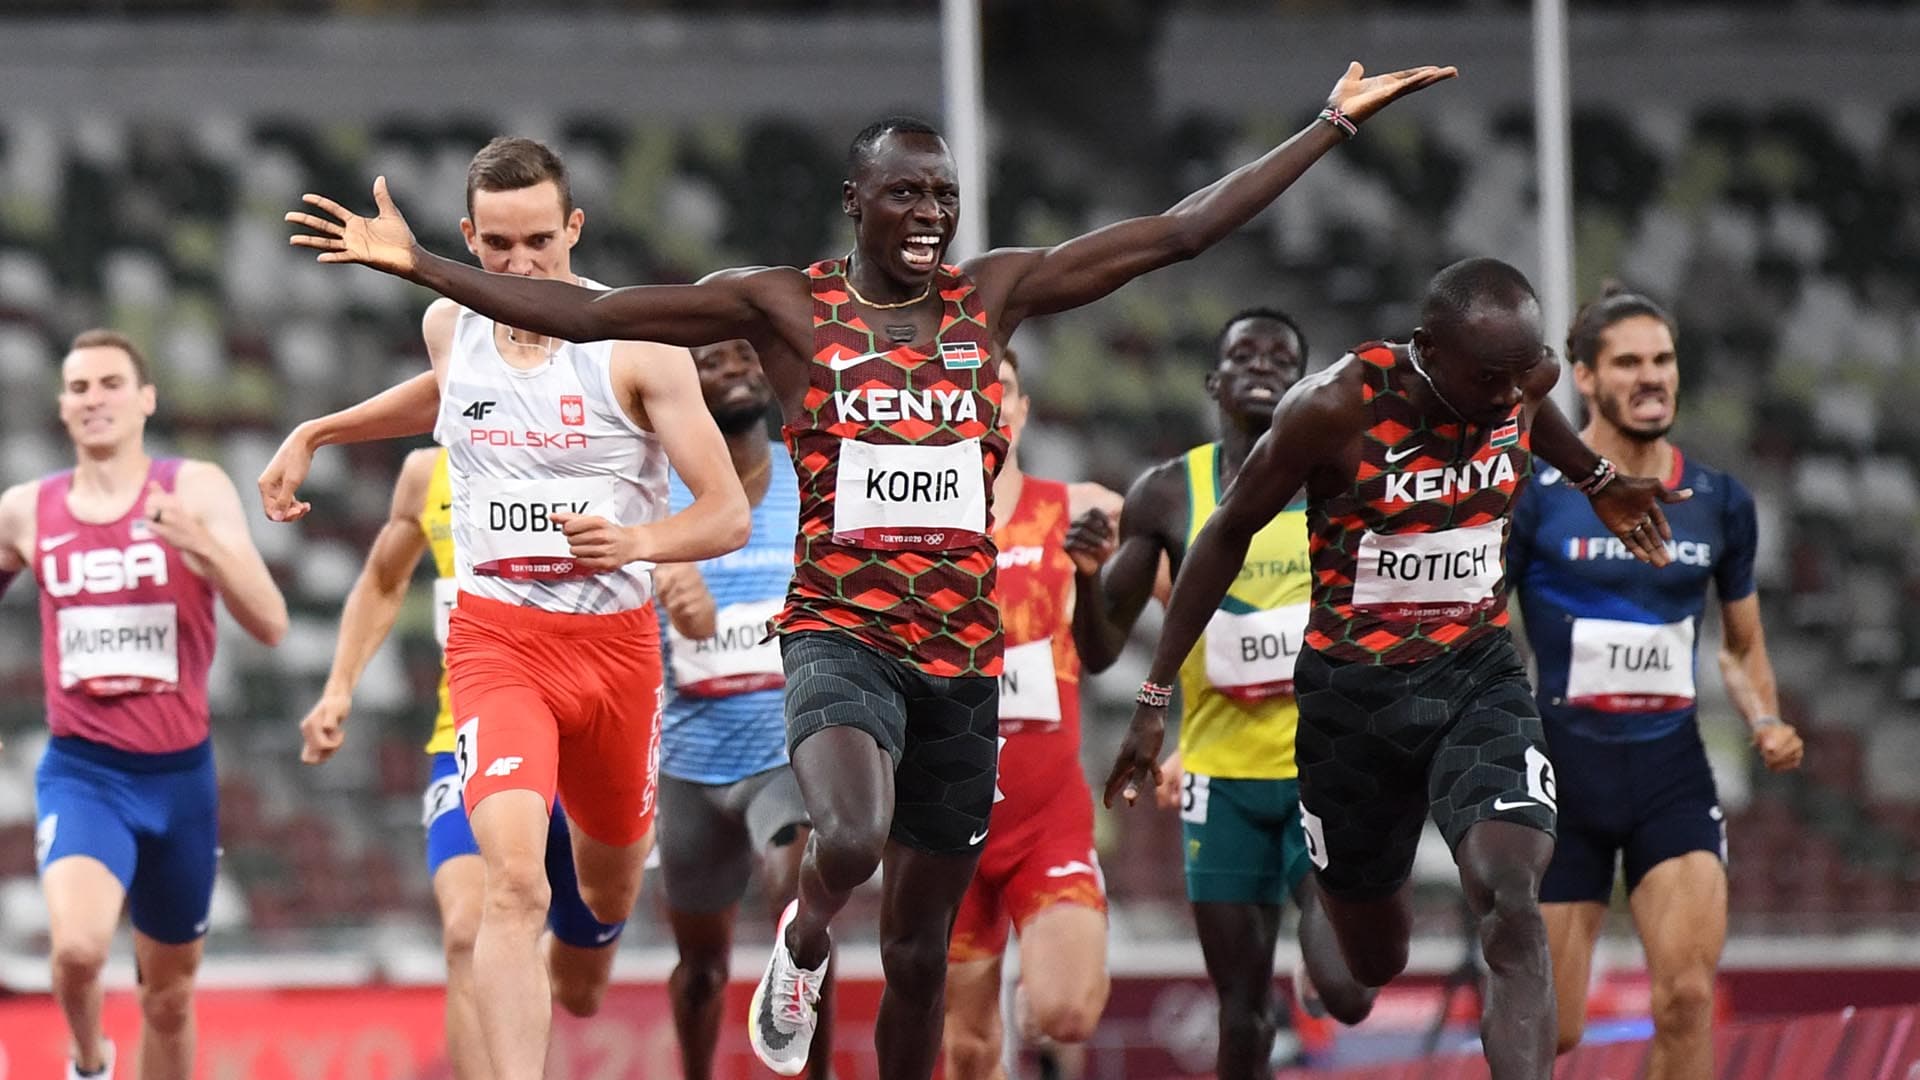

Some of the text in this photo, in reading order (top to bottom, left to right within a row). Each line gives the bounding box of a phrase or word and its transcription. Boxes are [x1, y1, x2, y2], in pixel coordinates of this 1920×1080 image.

[463, 401, 496, 420] 4F
[834, 388, 978, 424] KENYA
[470, 429, 587, 449] POLSKA
[866, 468, 959, 502] KORIR
[1384, 453, 1515, 503] KENYA
[880, 534, 903, 543] TOKYO
[1588, 537, 1711, 567] FRNCE
[41, 543, 169, 598] USA
[1377, 545, 1487, 581] ROTICH
[64, 626, 168, 654] MURPHY
[1241, 631, 1298, 662] BOL
[1607, 643, 1674, 672] TUAL
[485, 757, 523, 777] 4F
